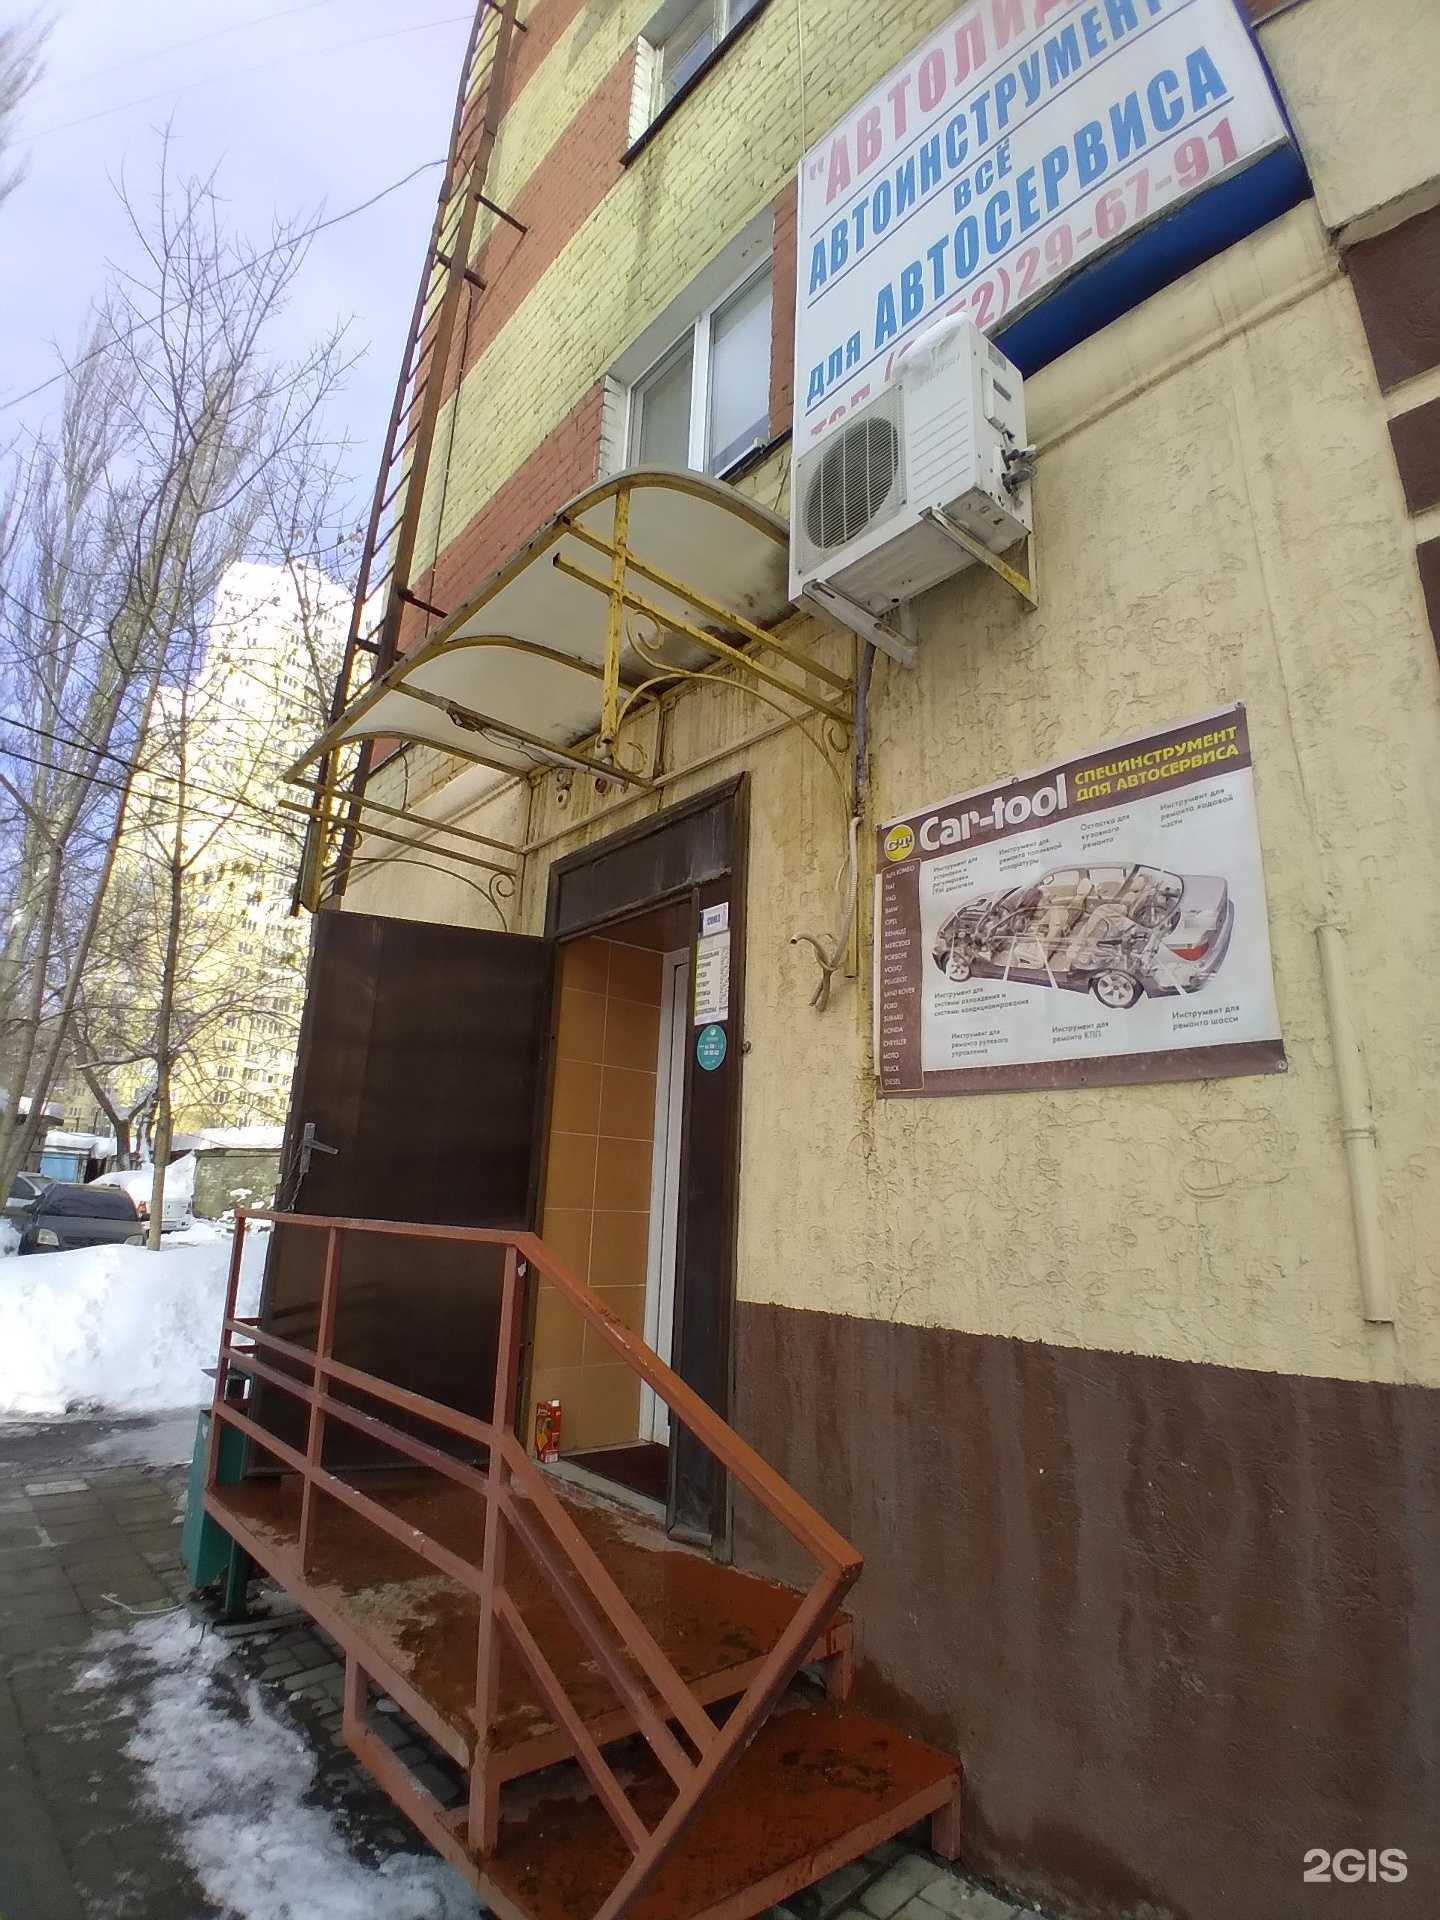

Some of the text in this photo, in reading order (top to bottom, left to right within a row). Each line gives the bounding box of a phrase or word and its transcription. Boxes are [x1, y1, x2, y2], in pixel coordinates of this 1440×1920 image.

[953, 137, 1013, 216] ВСЁ
[875, 46, 1228, 350] АВТОСЕРВИСА
[1073, 725, 1237, 786] СПЕЦИНСТРУМЕНТ
[1076, 743, 1240, 802] ДЛЯ АВТОСЕРВИСА
[919, 773, 1068, 851] Car-tool
[1160, 793, 1208, 811] Инструмент
[1052, 1021, 1109, 1033] Инструмент для
[1172, 1004, 1240, 1020] Инструмент для
[1172, 1017, 1239, 1031] ремонта шасси
[1052, 1034, 1082, 1044] ремонта
